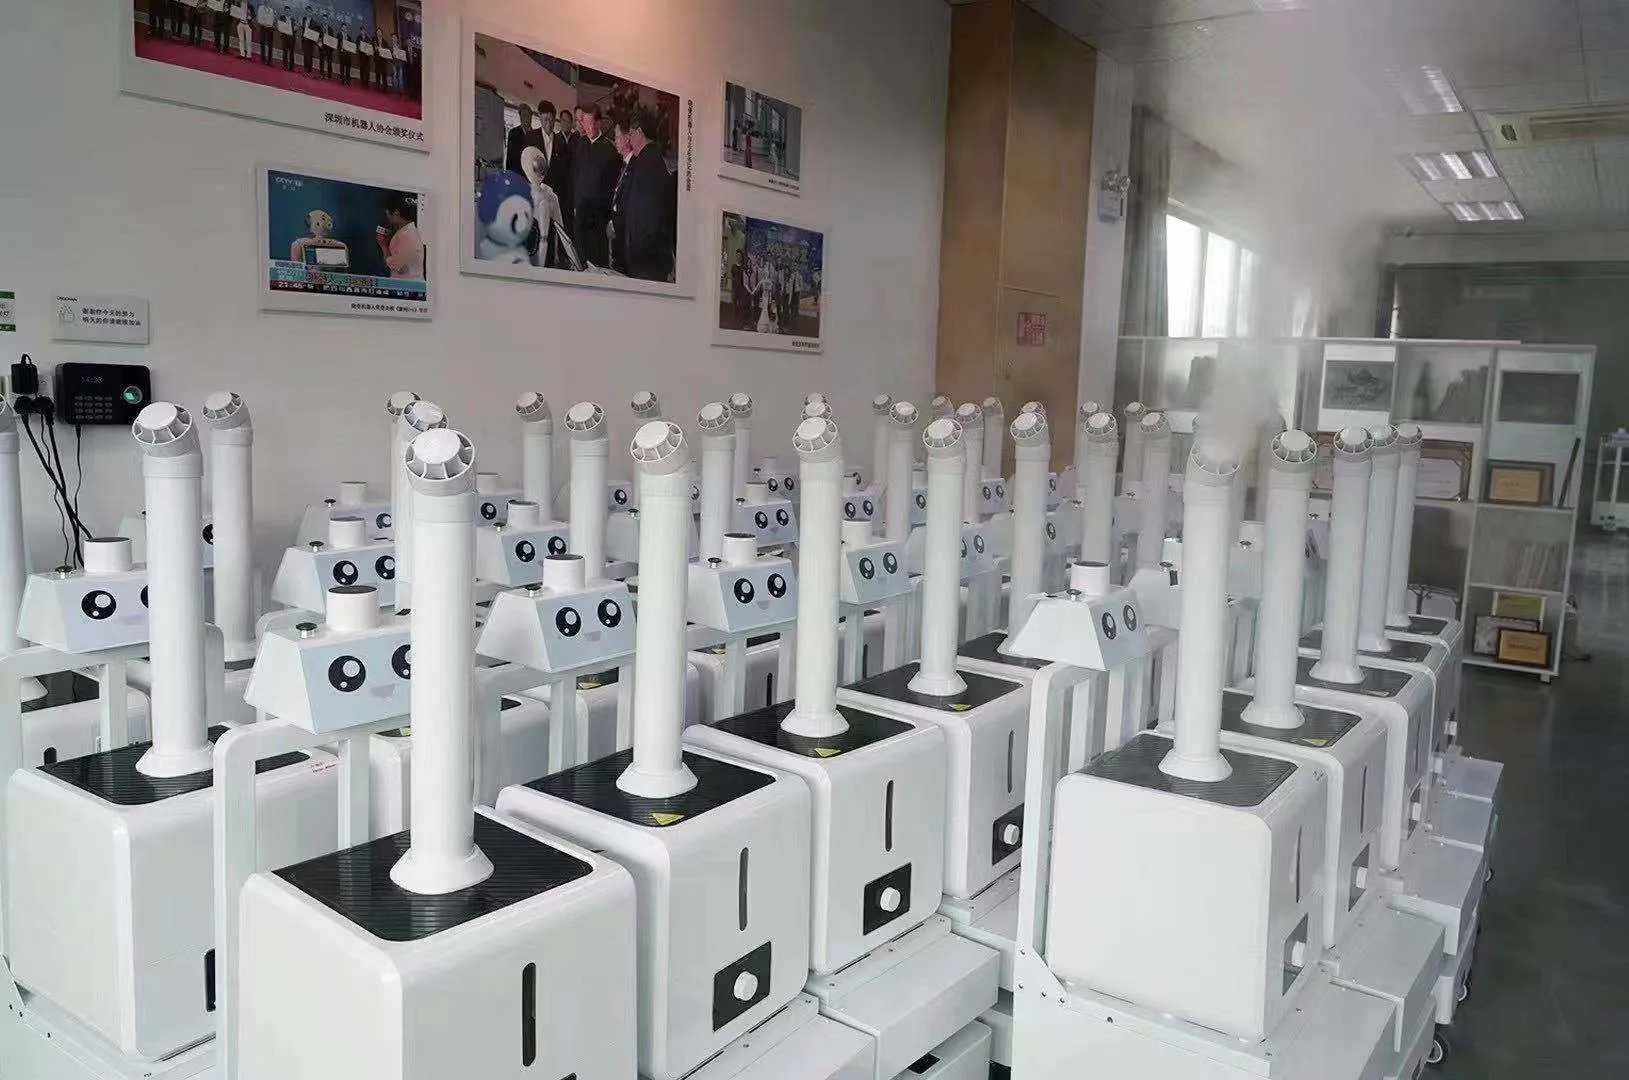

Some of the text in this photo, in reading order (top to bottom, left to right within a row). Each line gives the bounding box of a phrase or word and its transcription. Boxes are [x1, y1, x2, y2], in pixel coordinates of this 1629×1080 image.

[324, 112, 424, 142] 深圳市机器人协会颁奖仪式
